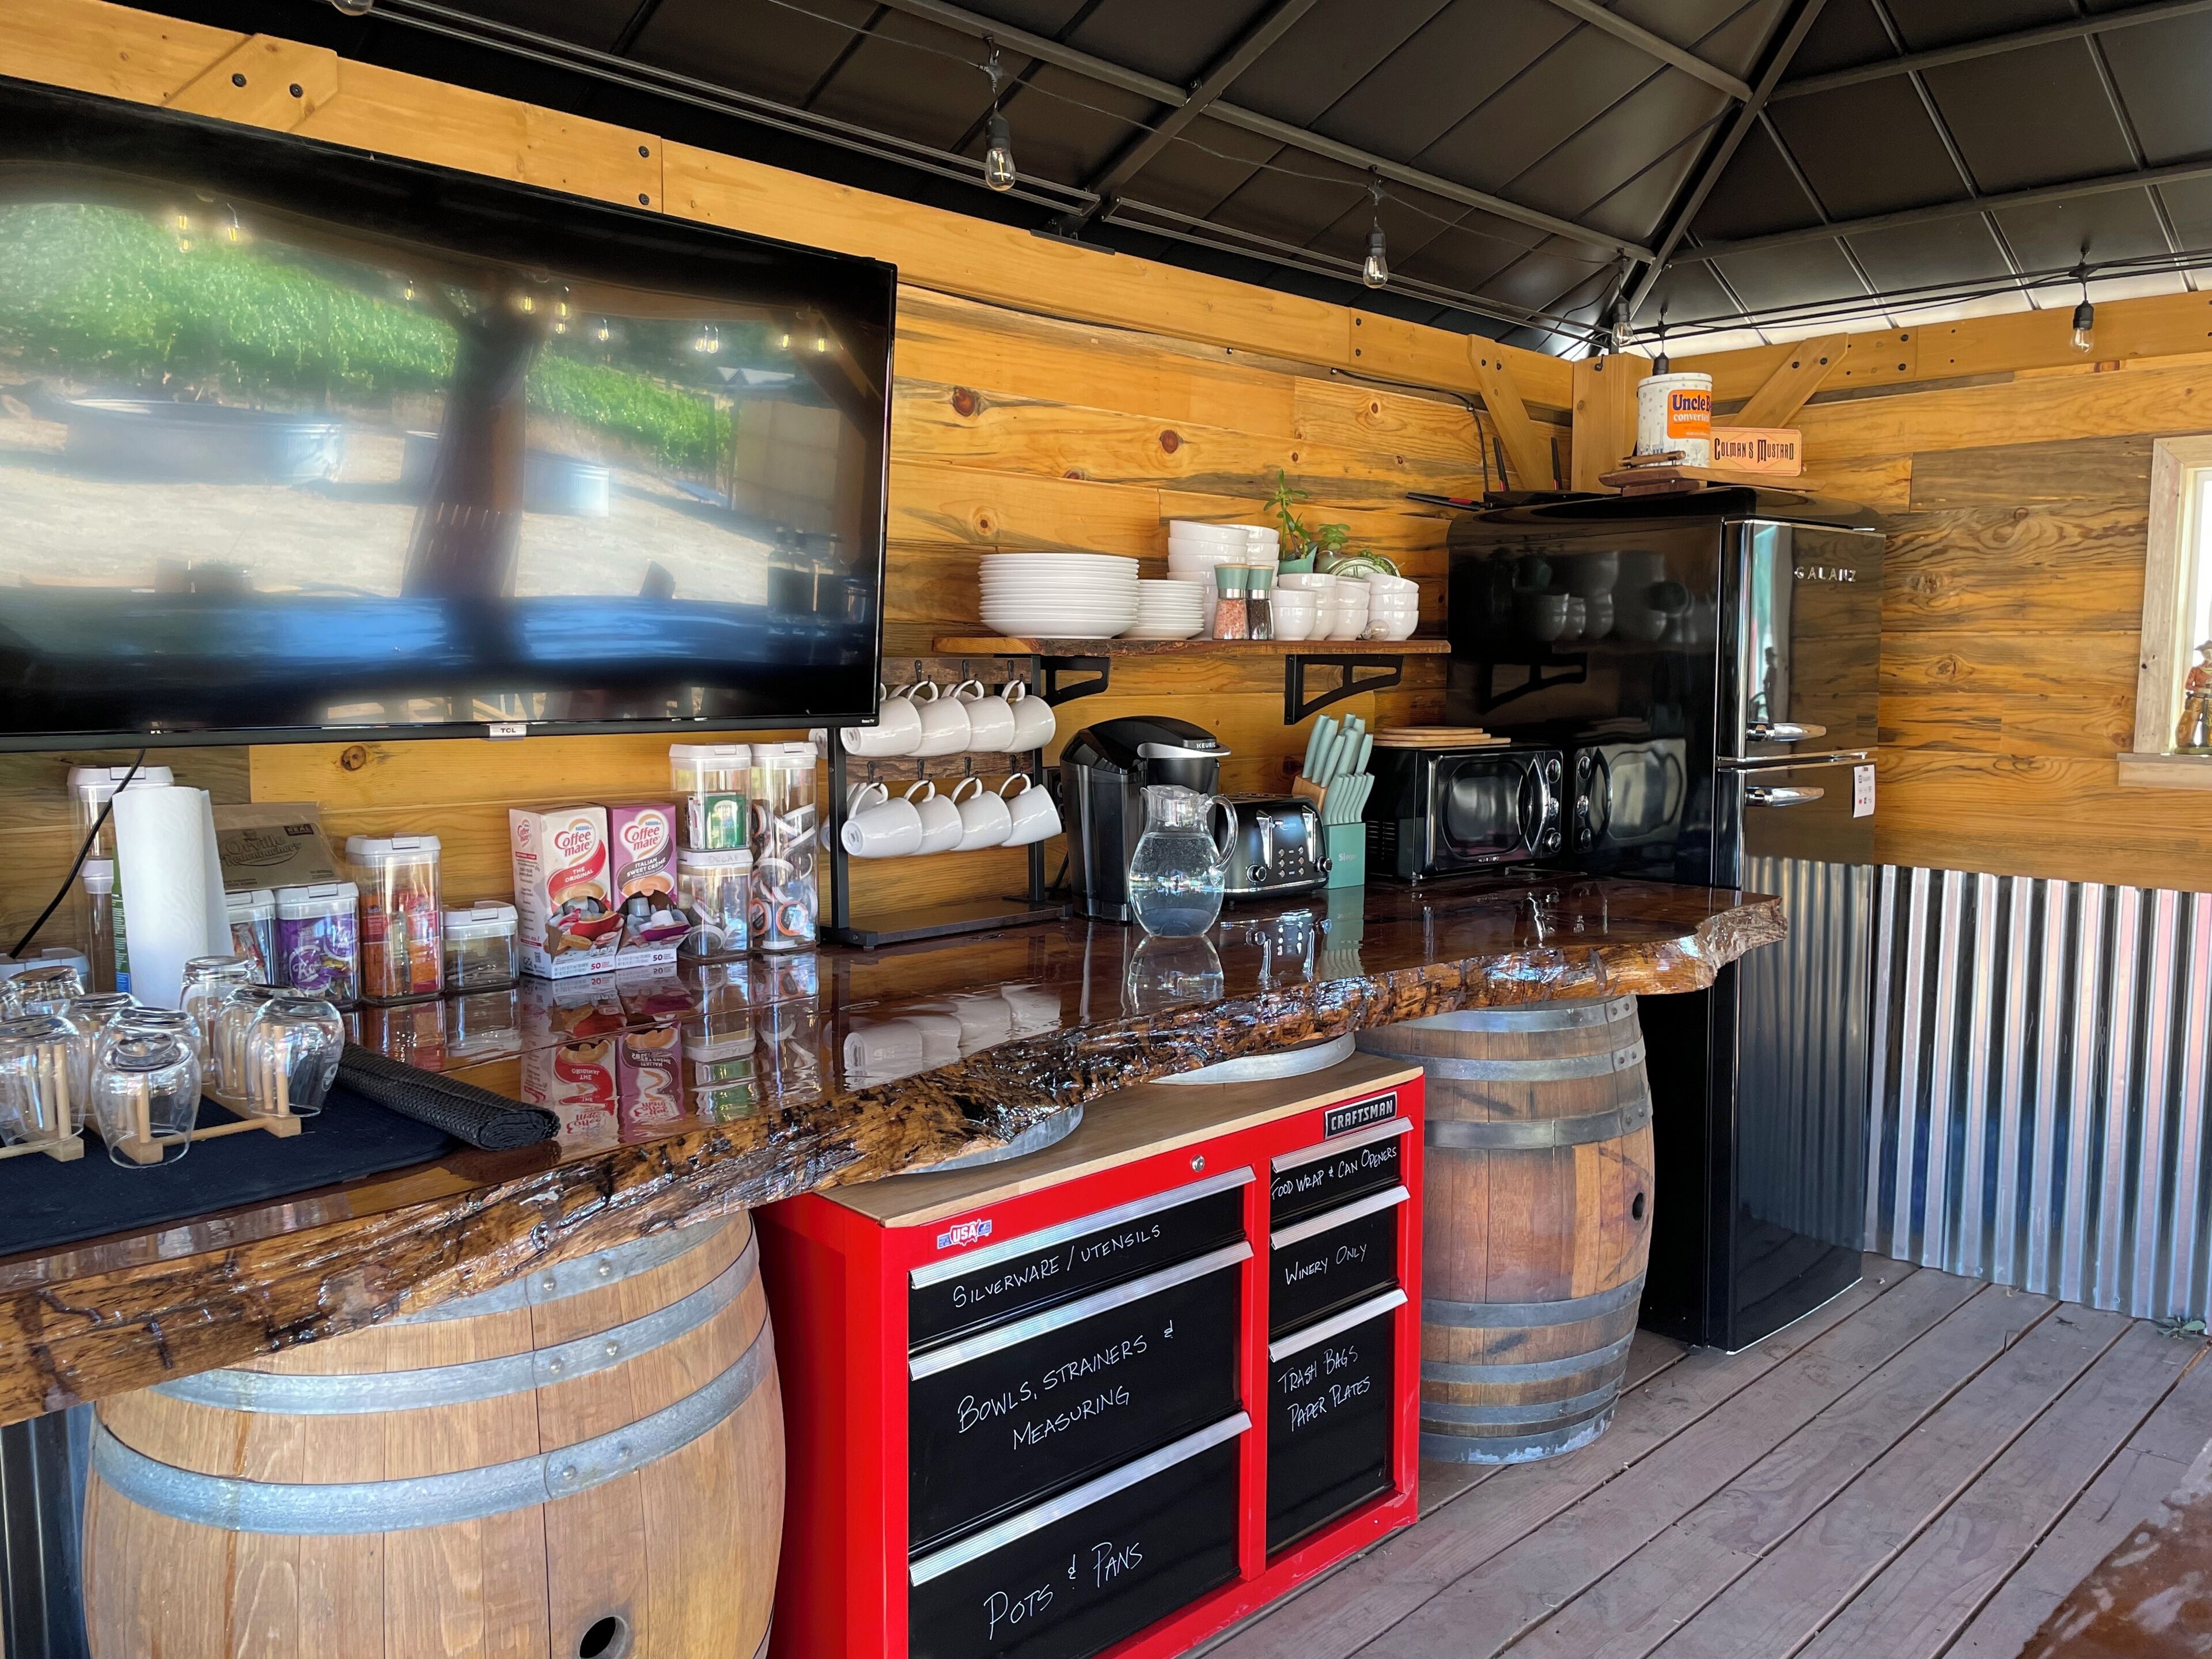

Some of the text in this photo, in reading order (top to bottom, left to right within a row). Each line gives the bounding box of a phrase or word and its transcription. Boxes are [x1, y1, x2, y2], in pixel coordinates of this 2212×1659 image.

[1672, 395, 1706, 411] Uncle
[1714, 438, 1794, 463] COLMAN'S MUSTARD
[1794, 566, 1856, 582] GALANZ
[555, 831, 591, 850] Coffee
[624, 825, 660, 844] Coffee
[633, 836, 658, 851] mate
[225, 835, 286, 855] Orville
[565, 842, 590, 857] mate
[573, 866, 585, 875] THE
[627, 866, 647, 877] SWEET
[635, 857, 657, 869] ITALIAN
[565, 869, 594, 883] ORIGINAL
[1331, 1100, 1393, 1131] CRAFTSMAN
[1270, 1177, 1293, 1200] FOOD
[1296, 1169, 1324, 1192] WRAP
[1338, 1161, 1358, 1179] CAN
[1361, 1147, 1397, 1168] OPENERS
[952, 1223, 978, 1243] USA
[953, 1255, 1060, 1308] SILVERWARE
[1081, 1224, 1161, 1263] UTENSILS
[1285, 1243, 1367, 1285] WINERY ONLY
[1278, 1345, 1358, 1393] TRASH BAGS
[957, 1381, 1037, 1434] BOWLS,
[1043, 1335, 1147, 1391] STRAINERS
[1287, 1376, 1370, 1432] PAPER PLATES
[1013, 1385, 1130, 1450] MEASURING
[983, 1584, 1053, 1641] POTS
[1091, 1542, 1143, 1588] PANS
